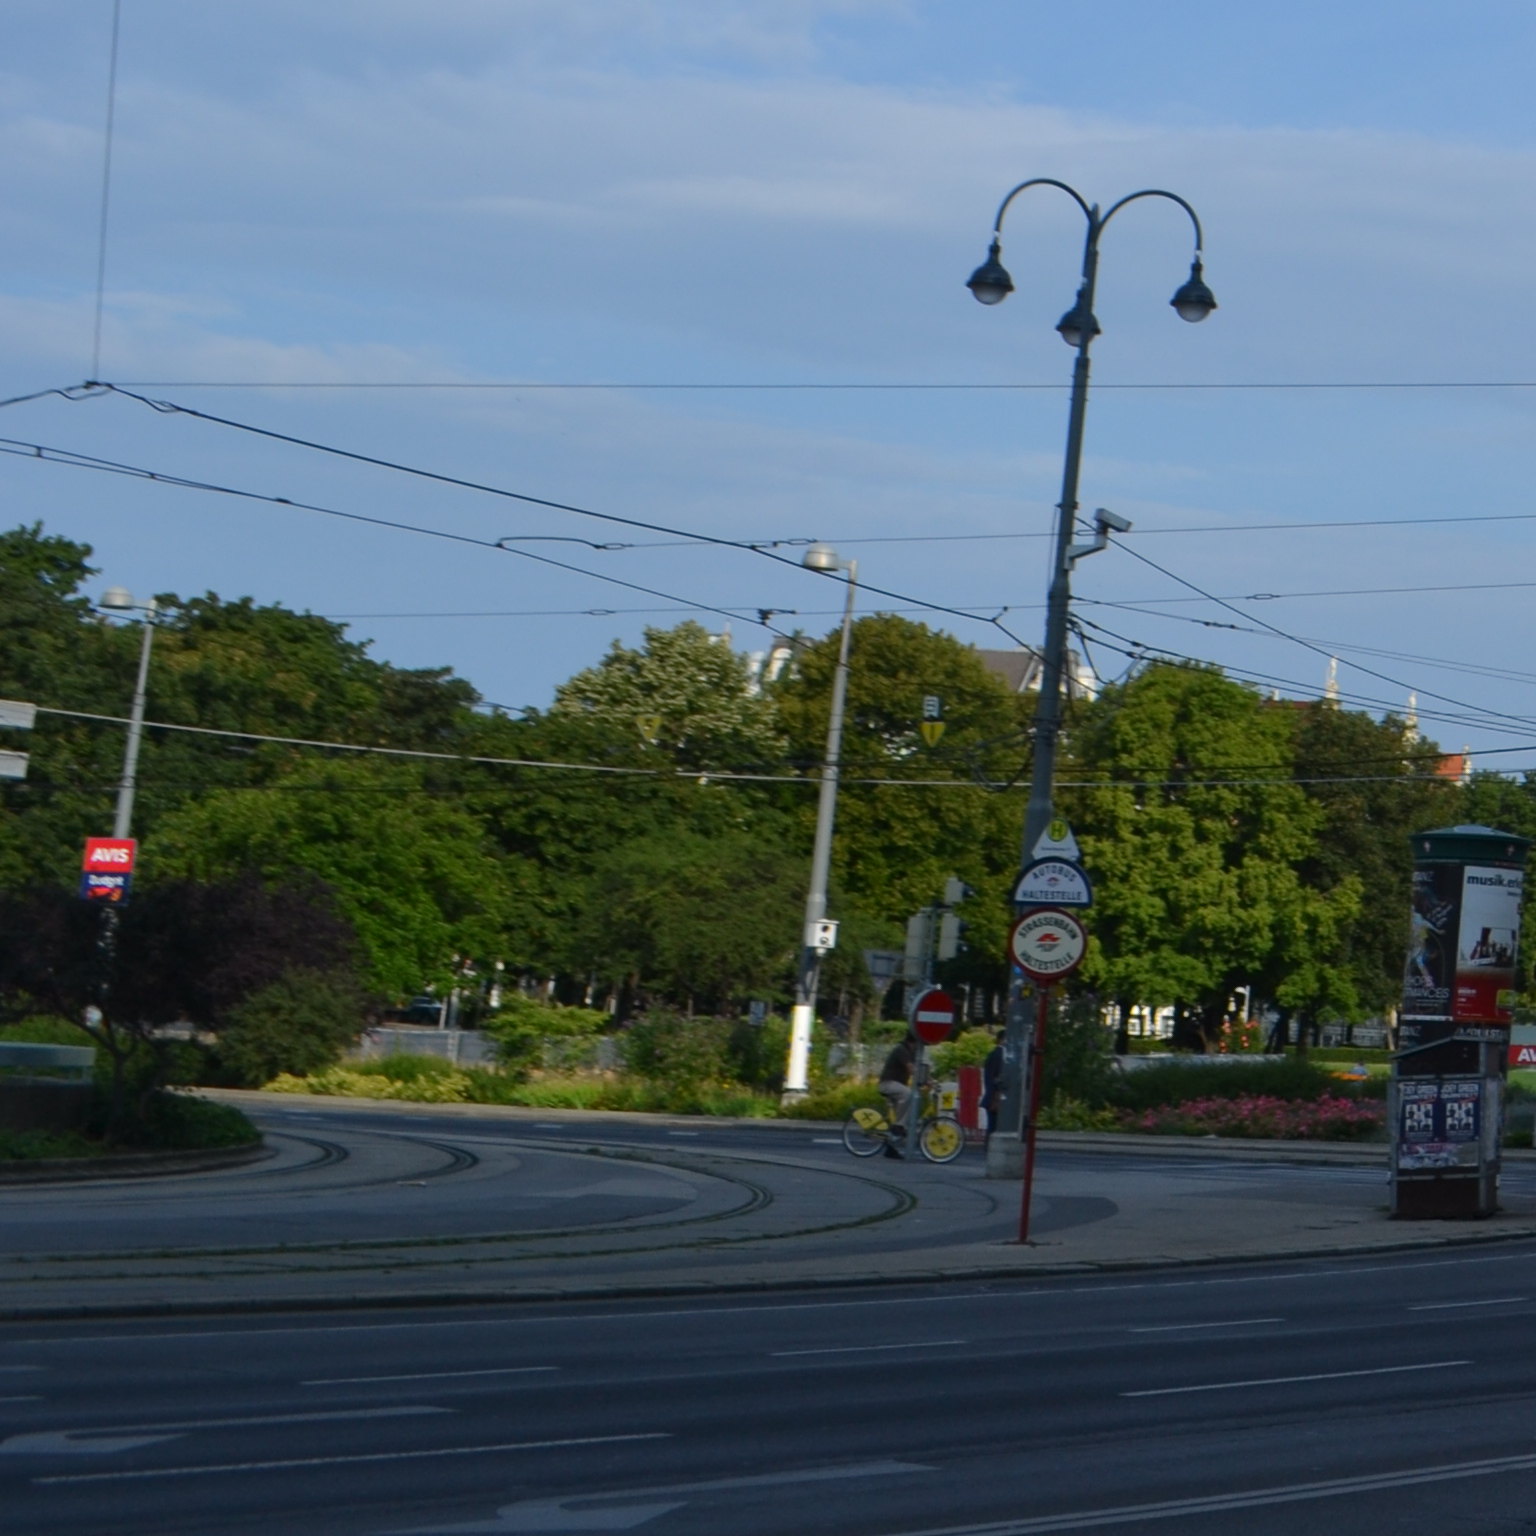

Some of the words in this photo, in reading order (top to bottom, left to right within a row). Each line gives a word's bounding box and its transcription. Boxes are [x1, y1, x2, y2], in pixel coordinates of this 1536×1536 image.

[90, 848, 131, 864] AVIS
[1032, 864, 1078, 882] AUTOBUS
[1021, 890, 1082, 901] HALTESTELLE
[1018, 916, 1078, 940] STRASSENBAHN
[1020, 950, 1074, 971] HALTESTELLE
